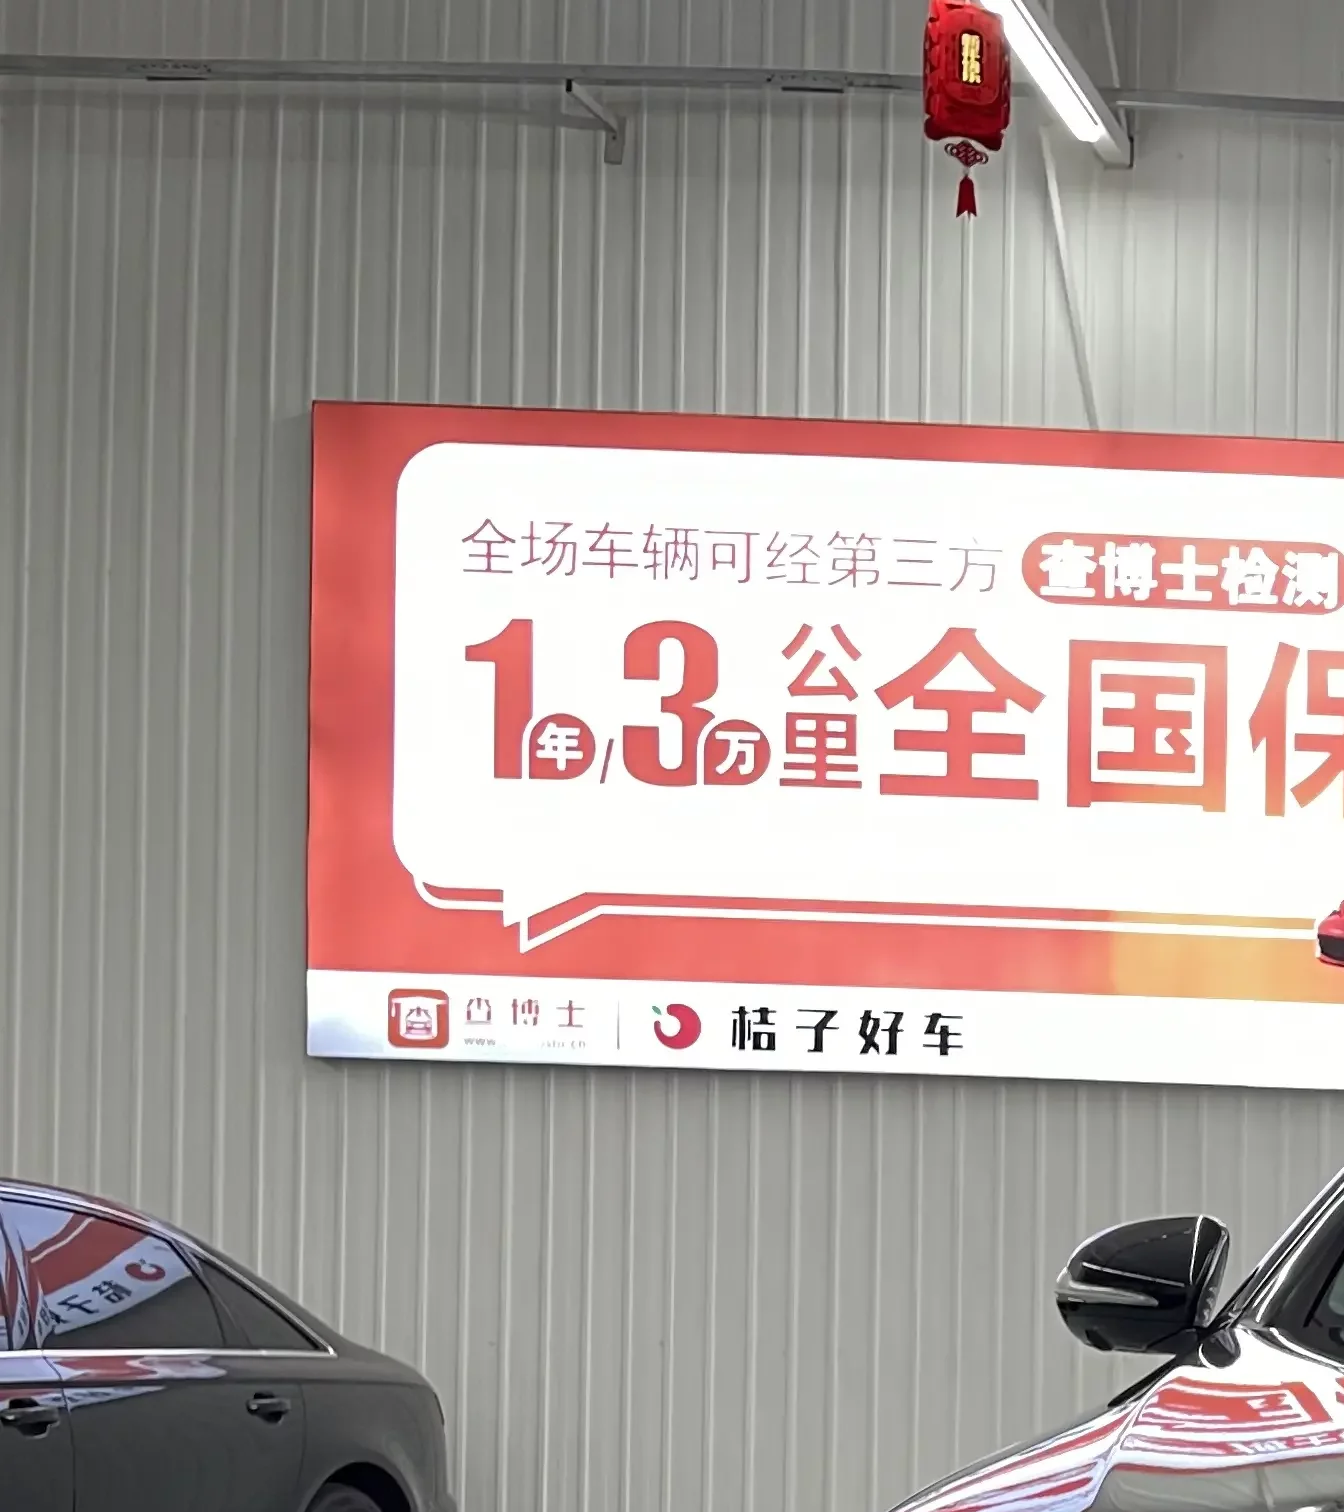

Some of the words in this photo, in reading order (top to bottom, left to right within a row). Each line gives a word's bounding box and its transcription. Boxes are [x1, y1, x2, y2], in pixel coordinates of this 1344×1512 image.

[461, 517, 1003, 593] 全场车辆可经第三方
[1039, 541, 1341, 610] 查博士检测
[731, 1005, 963, 1056] 桔子好车
